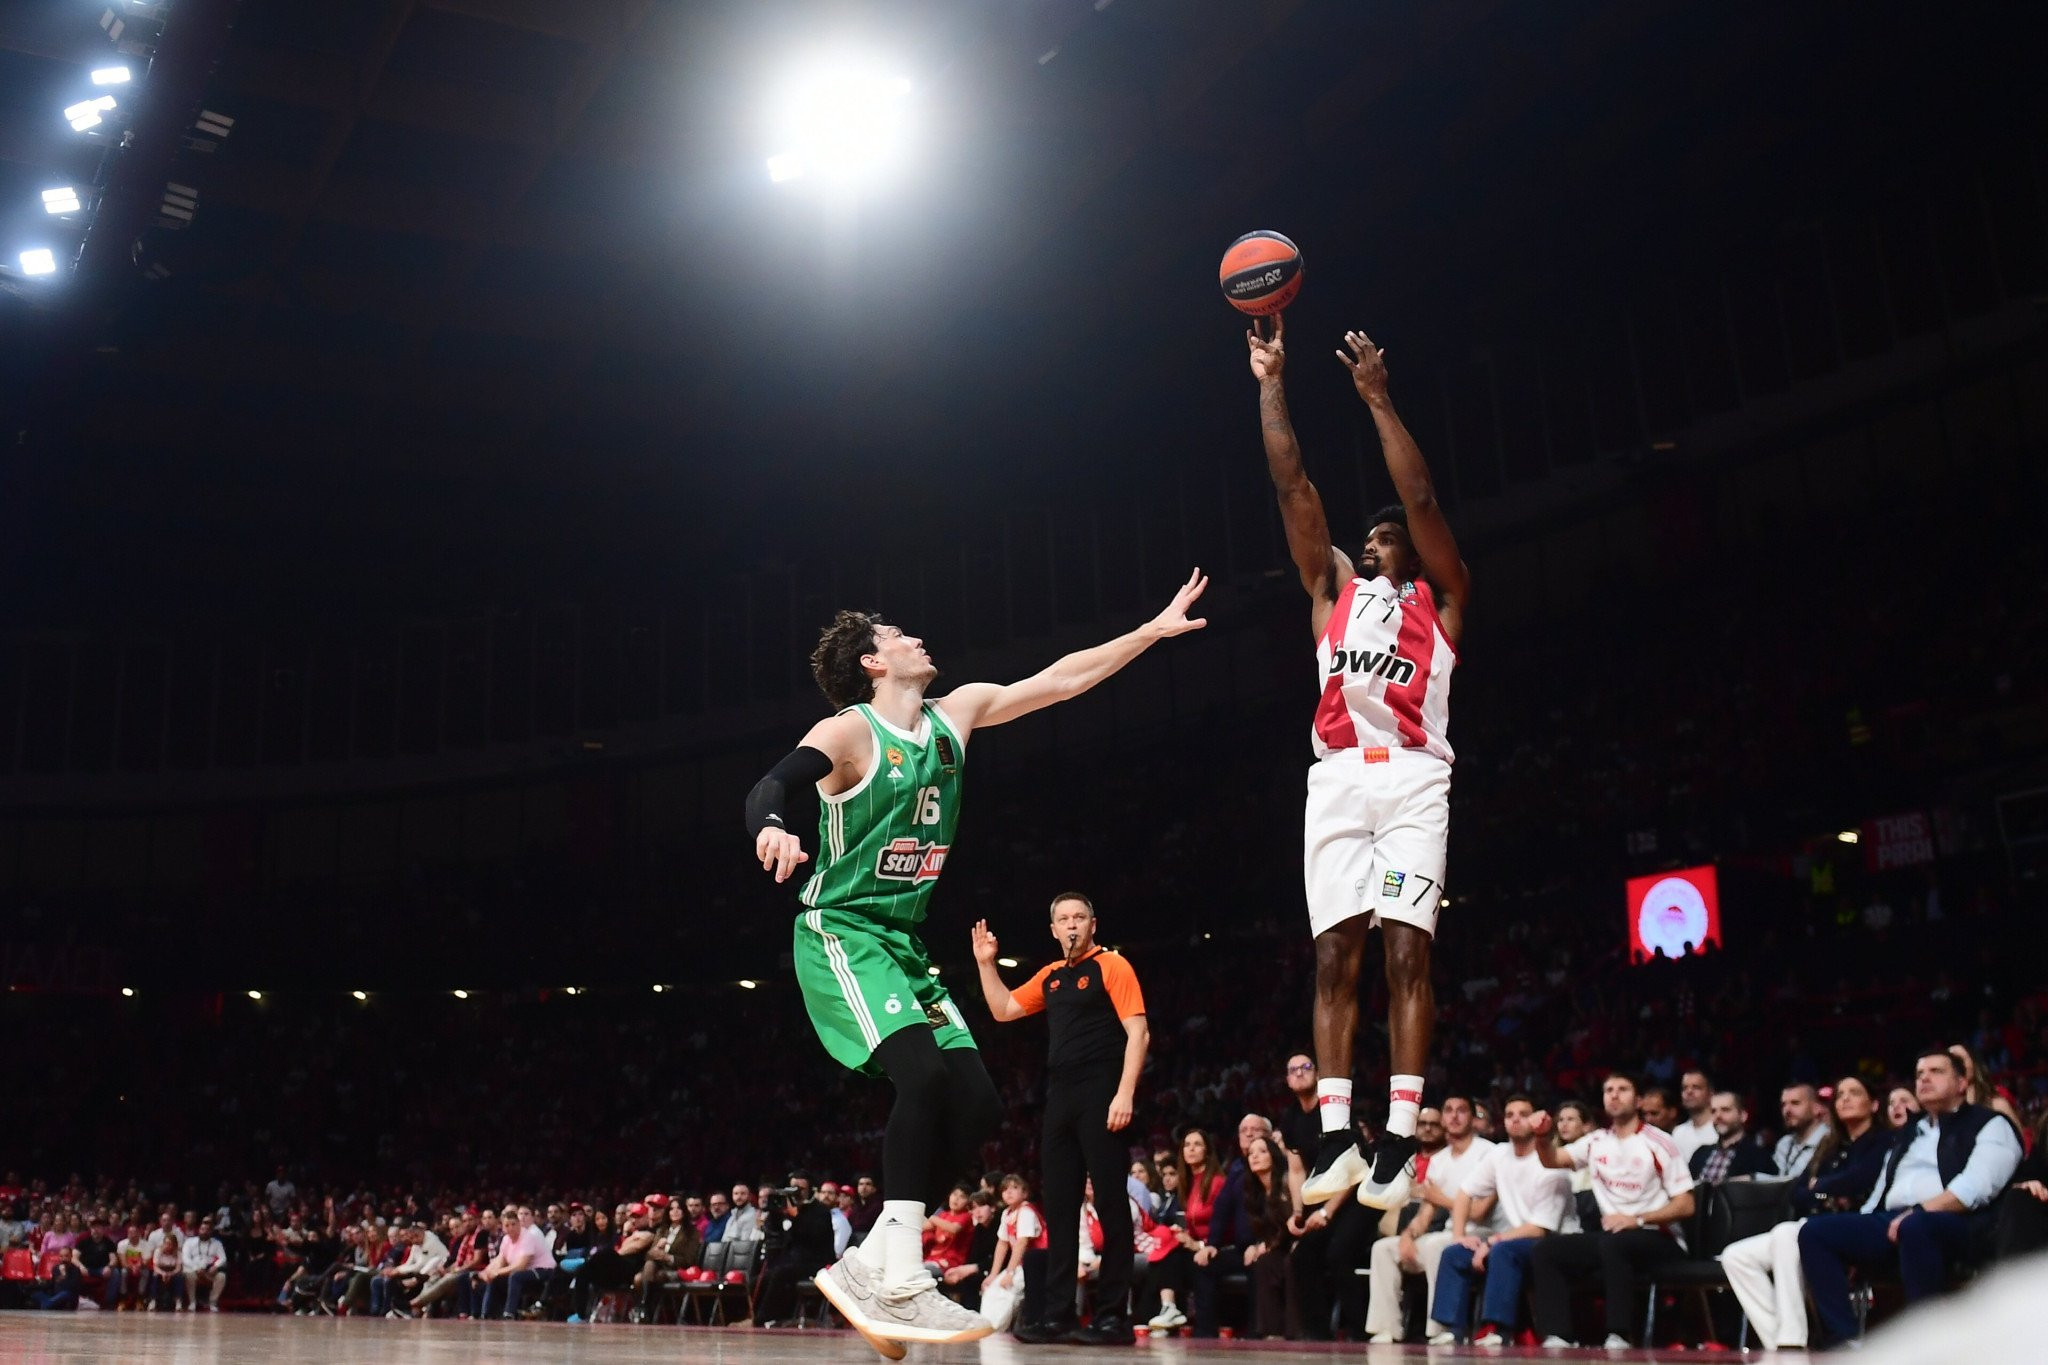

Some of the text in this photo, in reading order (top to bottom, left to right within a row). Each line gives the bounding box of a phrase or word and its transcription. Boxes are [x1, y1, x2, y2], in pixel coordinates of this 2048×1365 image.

[1356, 593, 1395, 624] 77
[1329, 643, 1415, 685] bwin
[912, 786, 940, 825] 16
[1876, 812, 1923, 842] THIS
